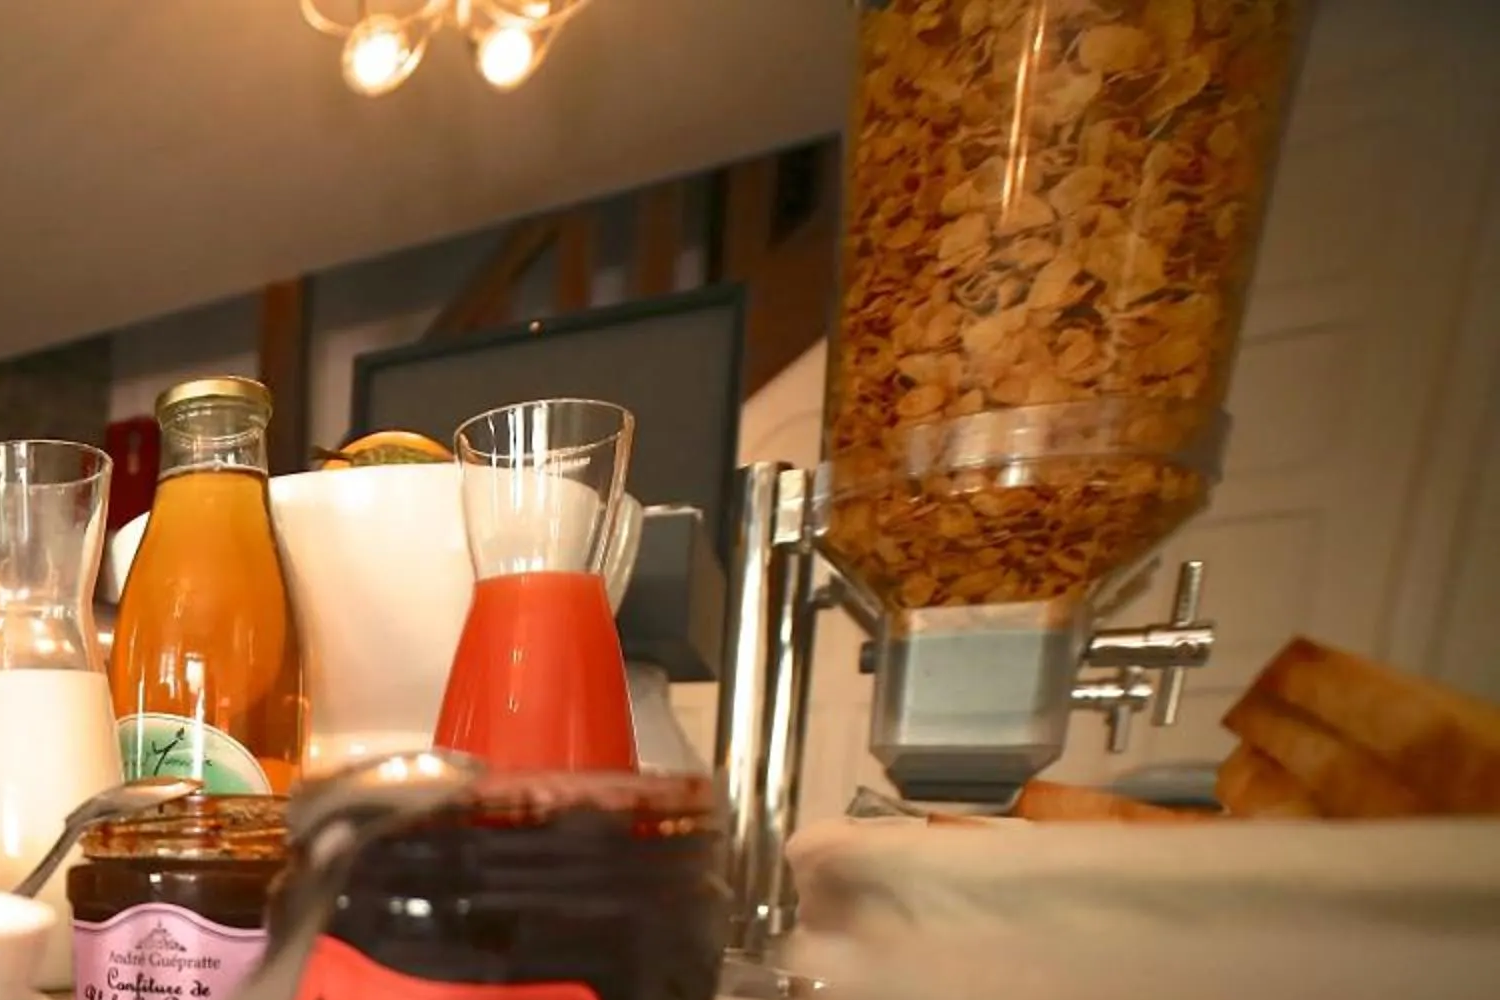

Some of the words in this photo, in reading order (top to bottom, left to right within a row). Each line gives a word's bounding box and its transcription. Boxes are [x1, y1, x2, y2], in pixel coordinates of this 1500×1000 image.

[109, 951, 146, 966] André
[148, 952, 221, 972] Guépratte
[190, 979, 211, 997] de
